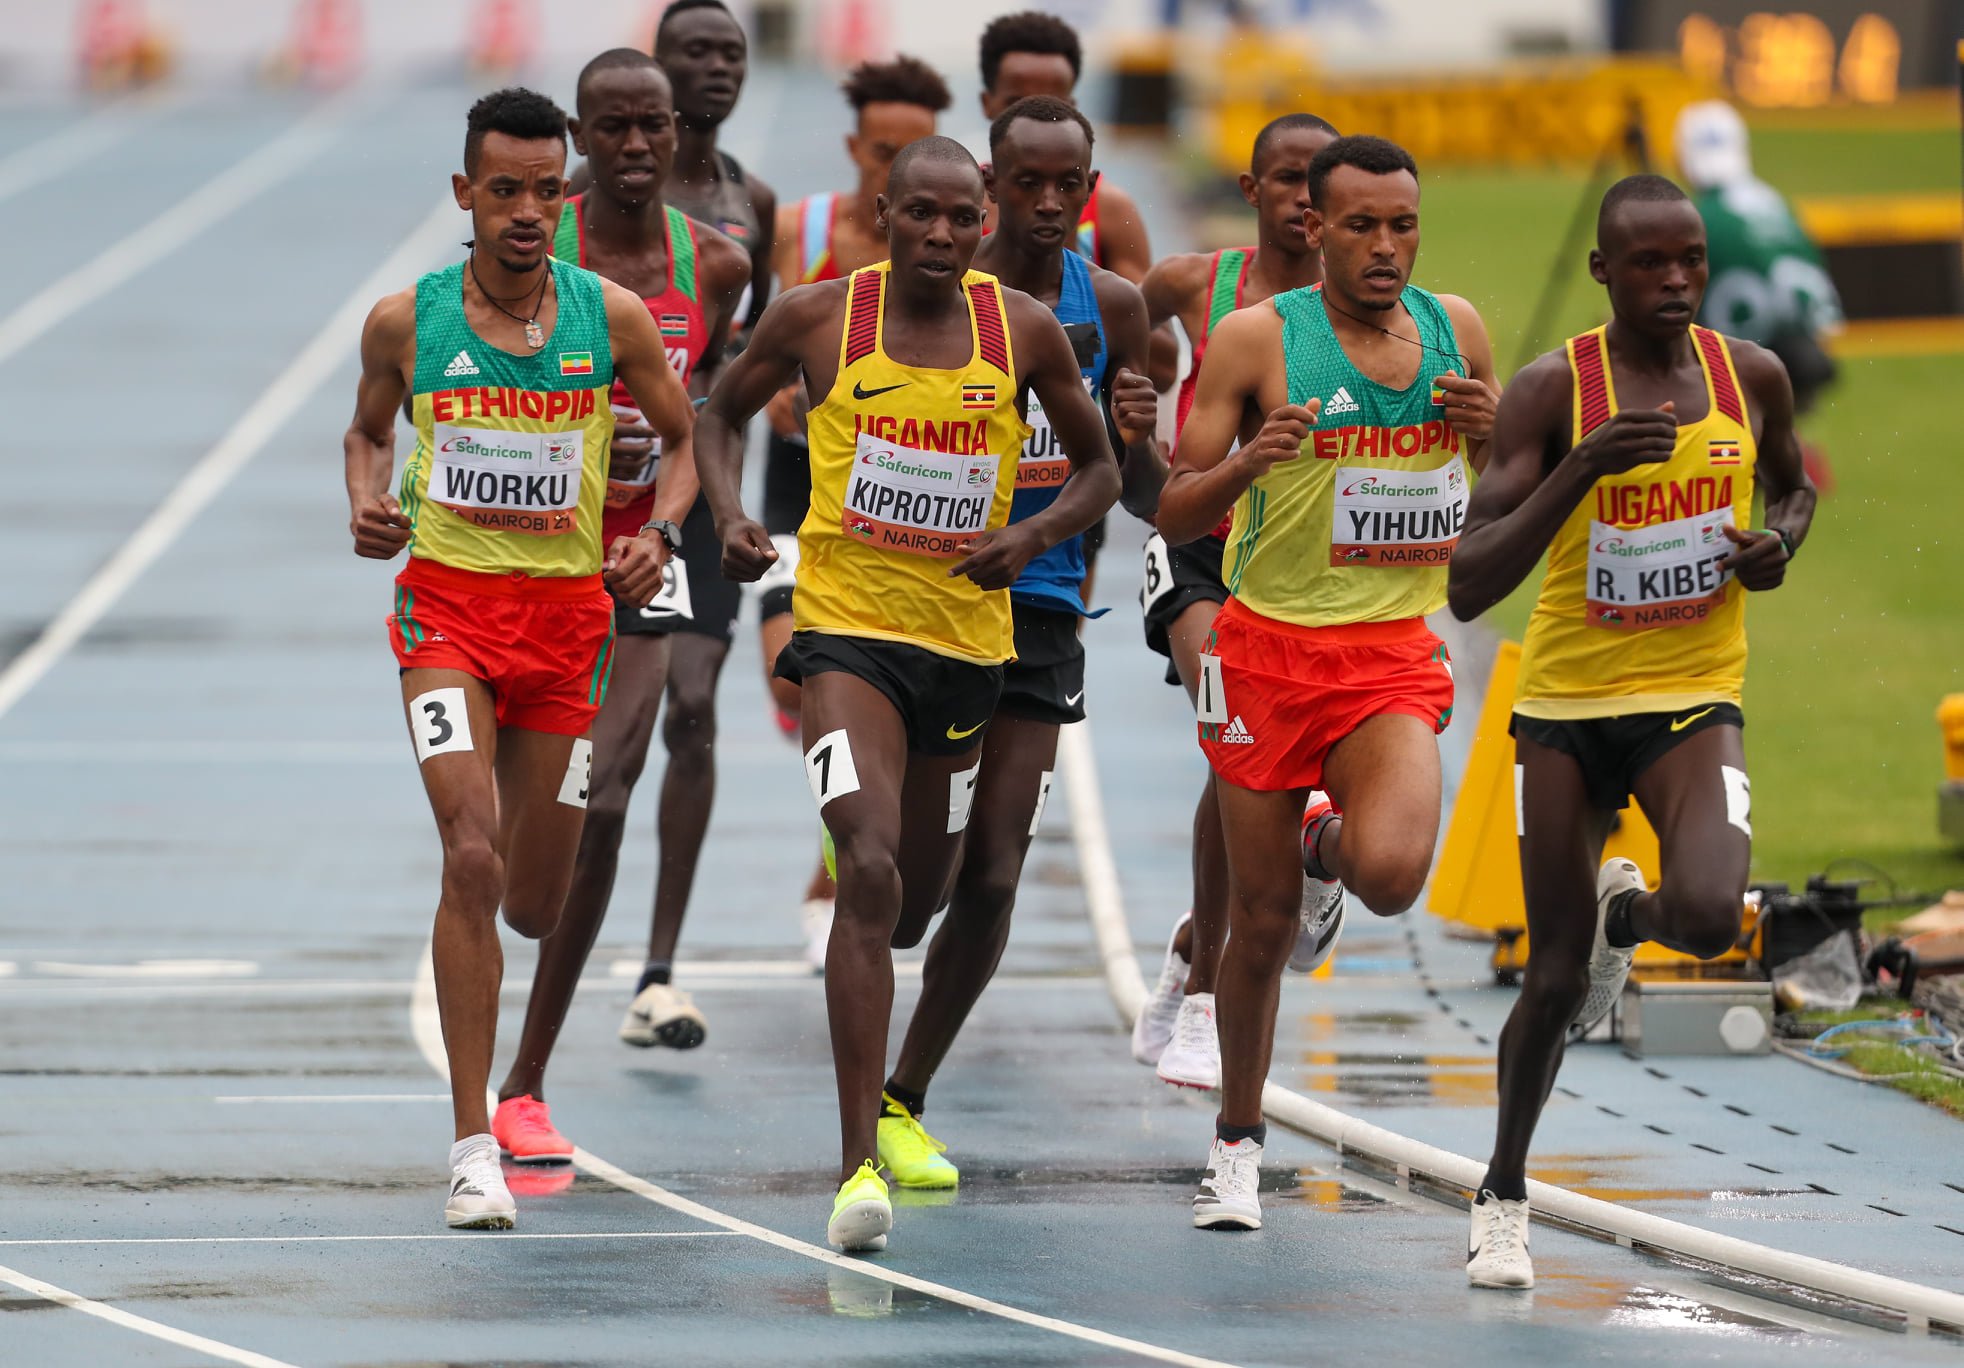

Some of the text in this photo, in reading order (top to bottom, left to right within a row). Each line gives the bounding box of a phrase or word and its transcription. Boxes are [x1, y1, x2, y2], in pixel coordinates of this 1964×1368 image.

[444, 365, 480, 377] adidas
[432, 386, 595, 422] ETHIOPIA
[1324, 402, 1360, 416] adidas
[455, 440, 533, 460] Safaricom
[855, 414, 989, 456] UGANDA
[876, 455, 953, 481] Safaricom
[1015, 467, 1065, 484] AIROBI
[446, 466, 568, 506] WORKU
[852, 477, 986, 529] KIPROTICH
[1360, 479, 1439, 497] Safaricom
[1597, 475, 1733, 526] UGANDA
[473, 512, 571, 532] NAIROBI 21
[1349, 499, 1465, 541] YIHUNE
[883, 529, 957, 553] NAIROBI
[1609, 537, 1686, 558] Safaricom
[1146, 551, 1161, 595] 8
[1596, 567, 1625, 601] R.
[1204, 666, 1213, 713] 1
[423, 701, 453, 747] 3
[1222, 733, 1255, 745] adidas
[813, 744, 833, 797] 7
